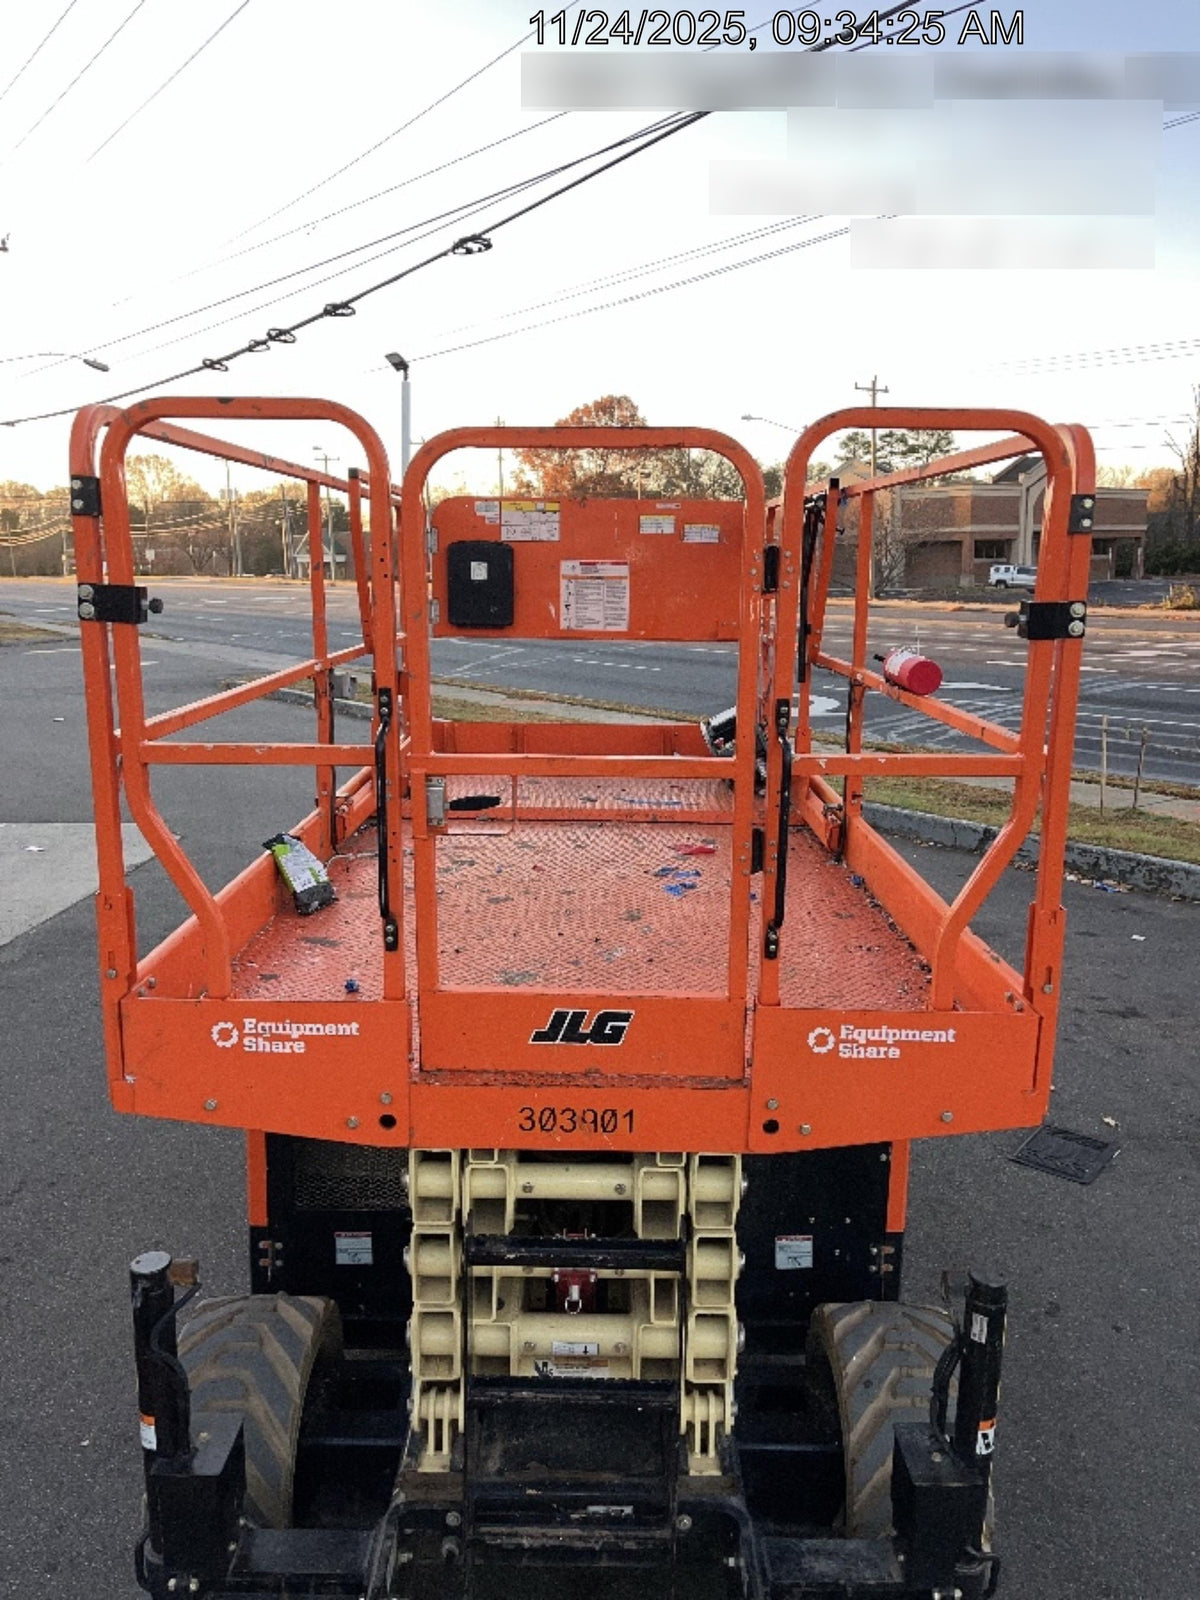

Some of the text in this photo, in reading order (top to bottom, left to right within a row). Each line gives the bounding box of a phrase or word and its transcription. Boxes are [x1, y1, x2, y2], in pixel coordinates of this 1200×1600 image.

[243, 1018, 360, 1039] Equipment
[528, 1007, 636, 1047] JLG
[243, 1036, 307, 1054] Share
[838, 1042, 901, 1059] Share
